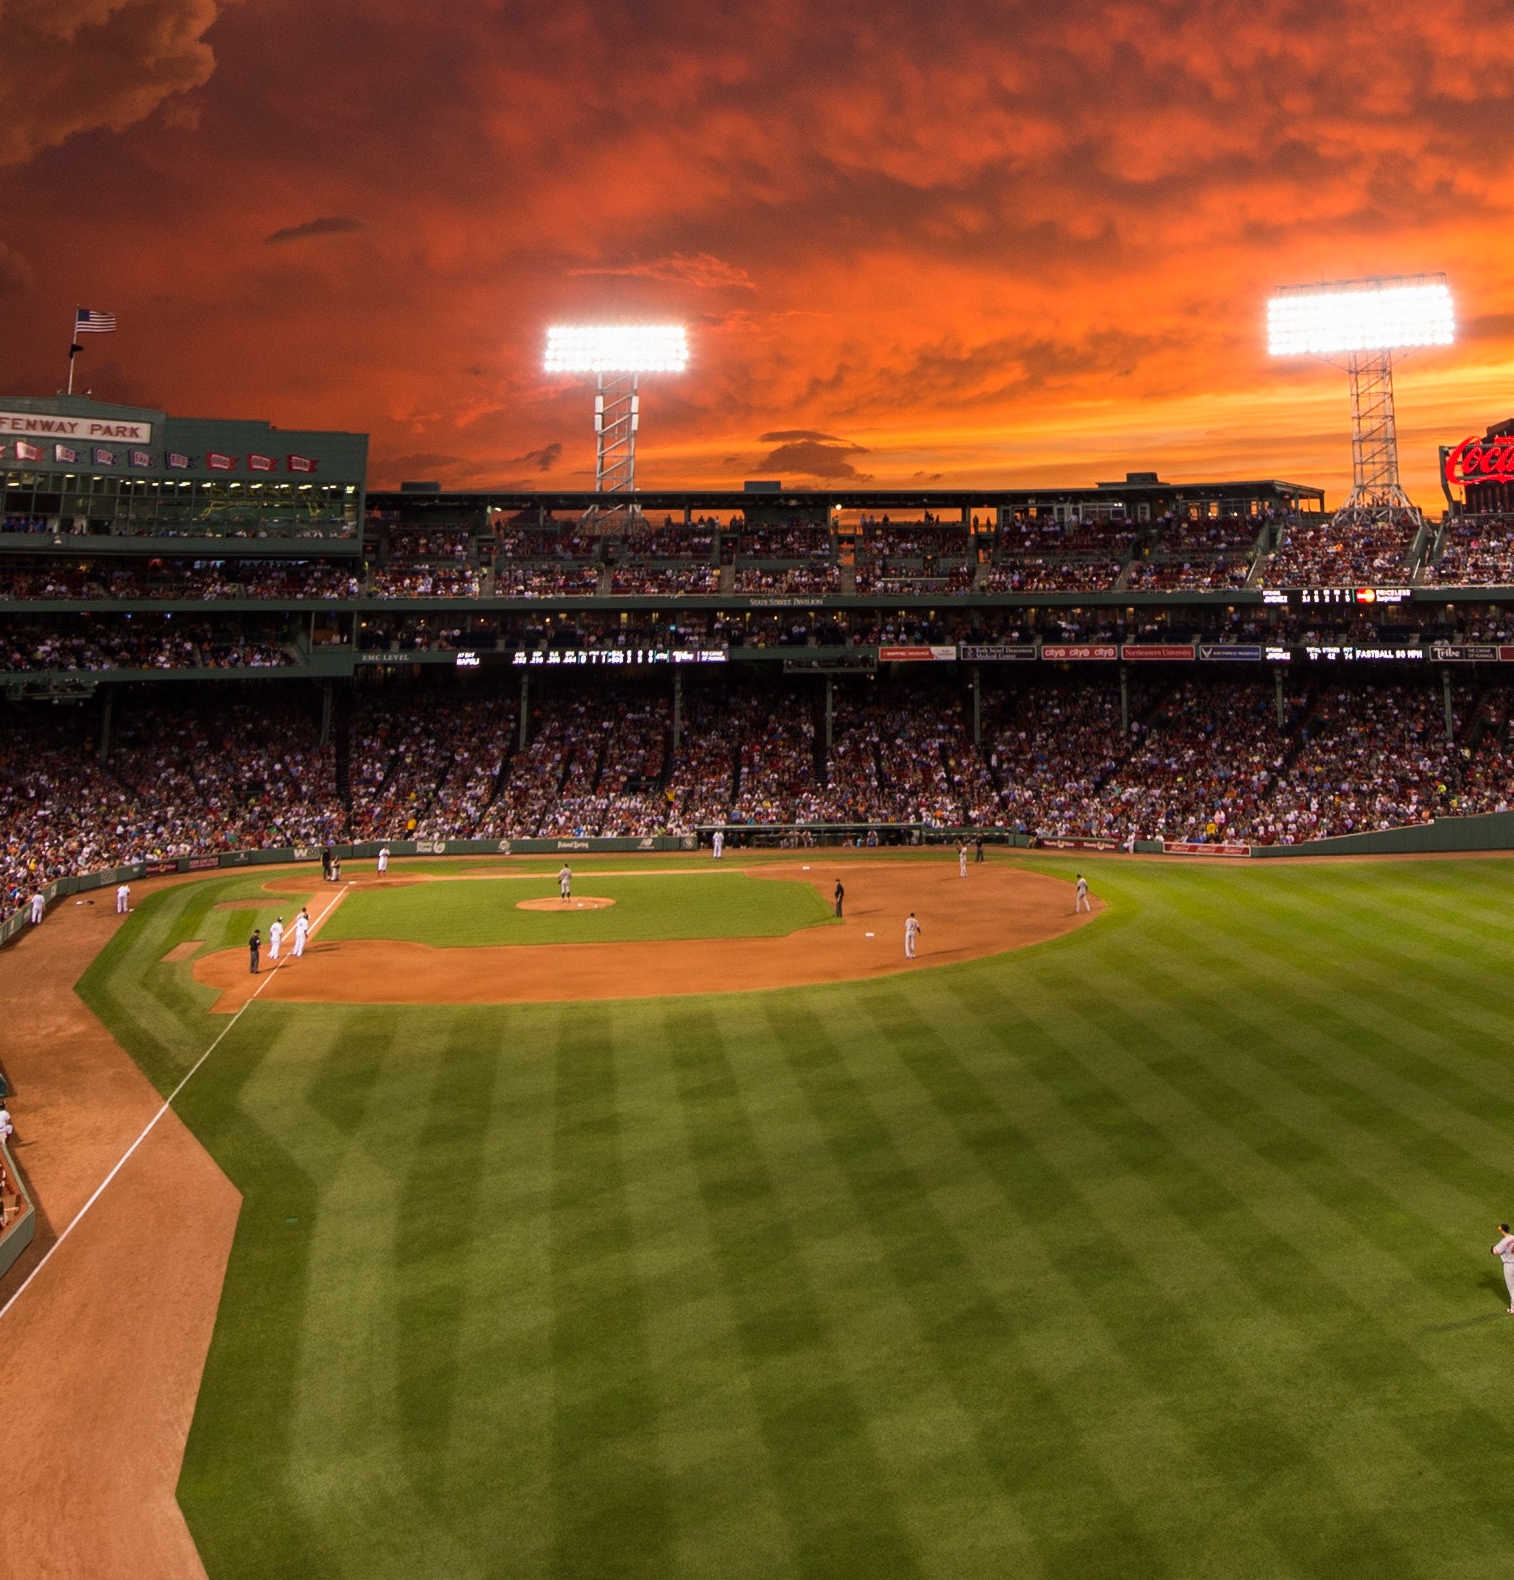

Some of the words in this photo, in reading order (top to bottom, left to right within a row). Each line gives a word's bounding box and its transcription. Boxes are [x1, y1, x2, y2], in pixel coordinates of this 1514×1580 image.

[90, 423, 141, 439] PARK
[383, 653, 410, 661] LEVEL
[1355, 649, 1394, 659] FASTBALL
[1433, 647, 1461, 659] Tribe
